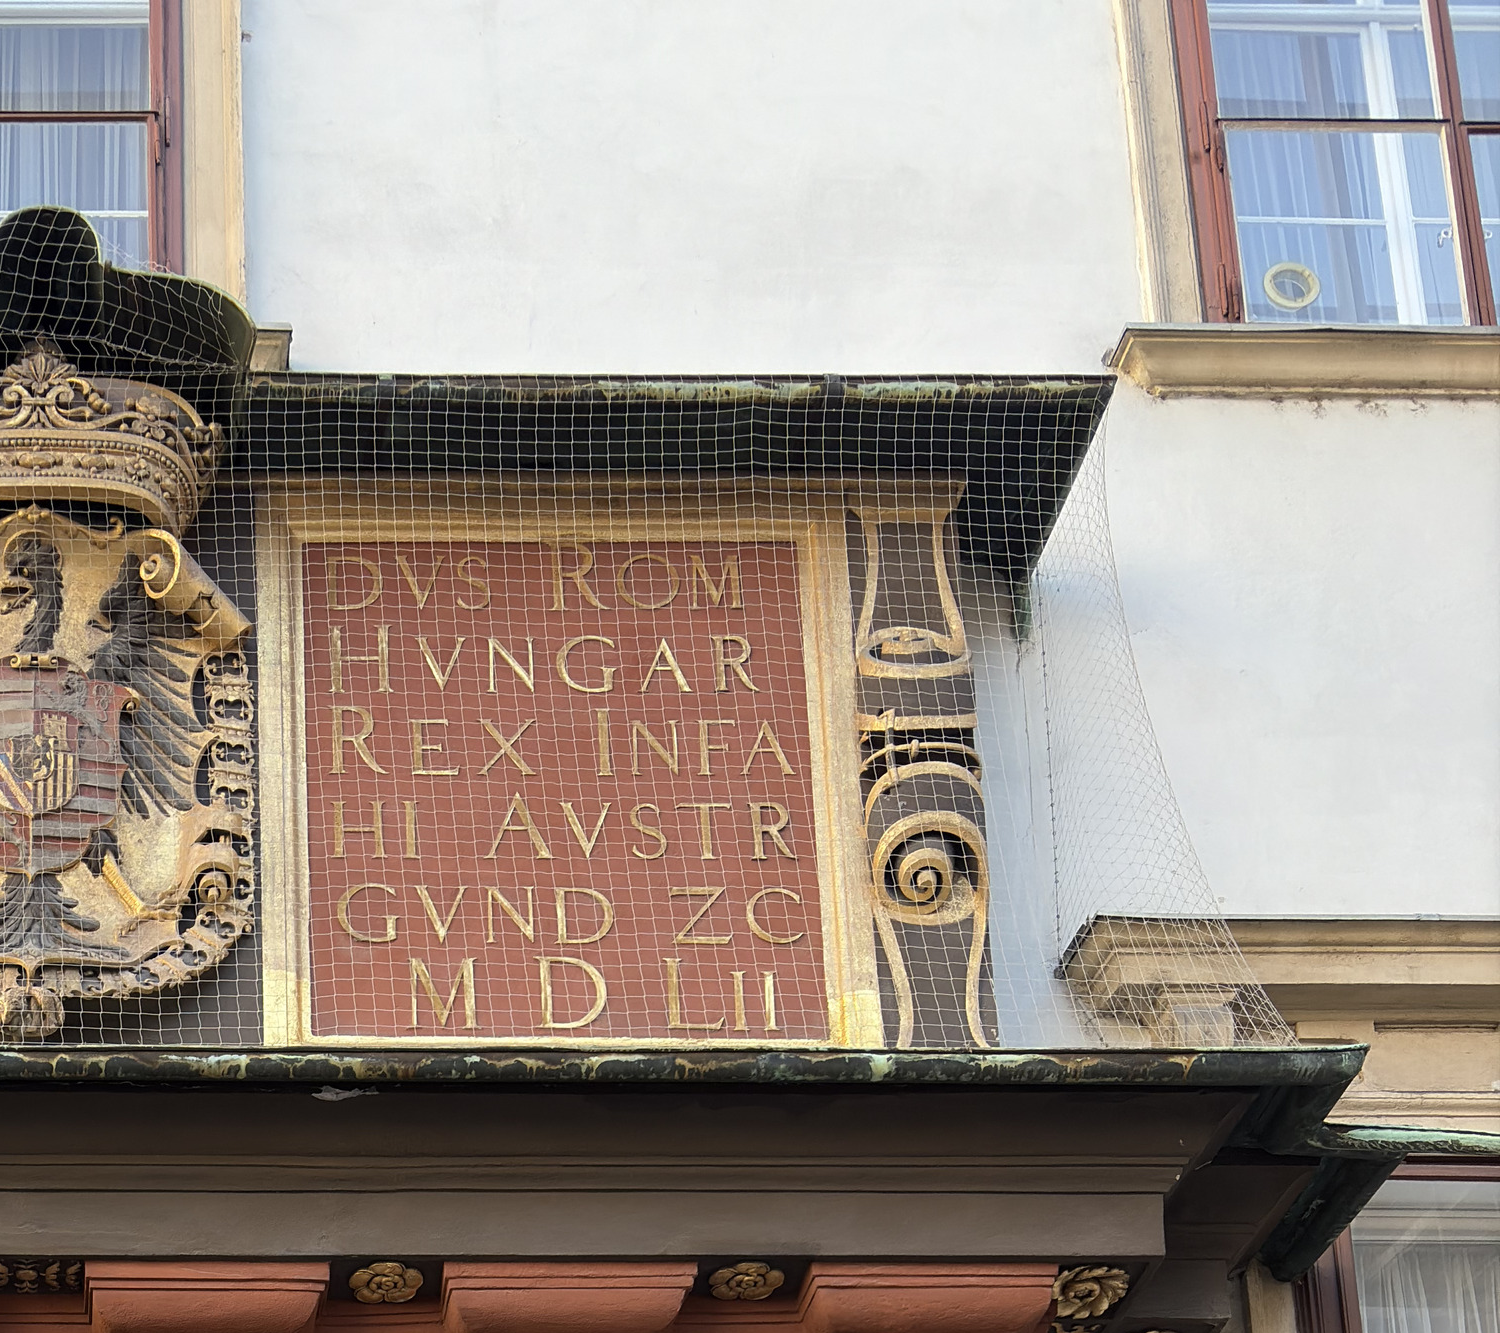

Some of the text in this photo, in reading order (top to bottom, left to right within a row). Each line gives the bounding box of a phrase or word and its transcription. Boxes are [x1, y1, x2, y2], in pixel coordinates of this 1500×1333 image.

[325, 540, 743, 611] DVS ROM
[327, 624, 760, 693] HVNGAR
[328, 705, 796, 776] REX INFA
[330, 791, 797, 860] HI AVSTR
[336, 883, 613, 944] GVND
